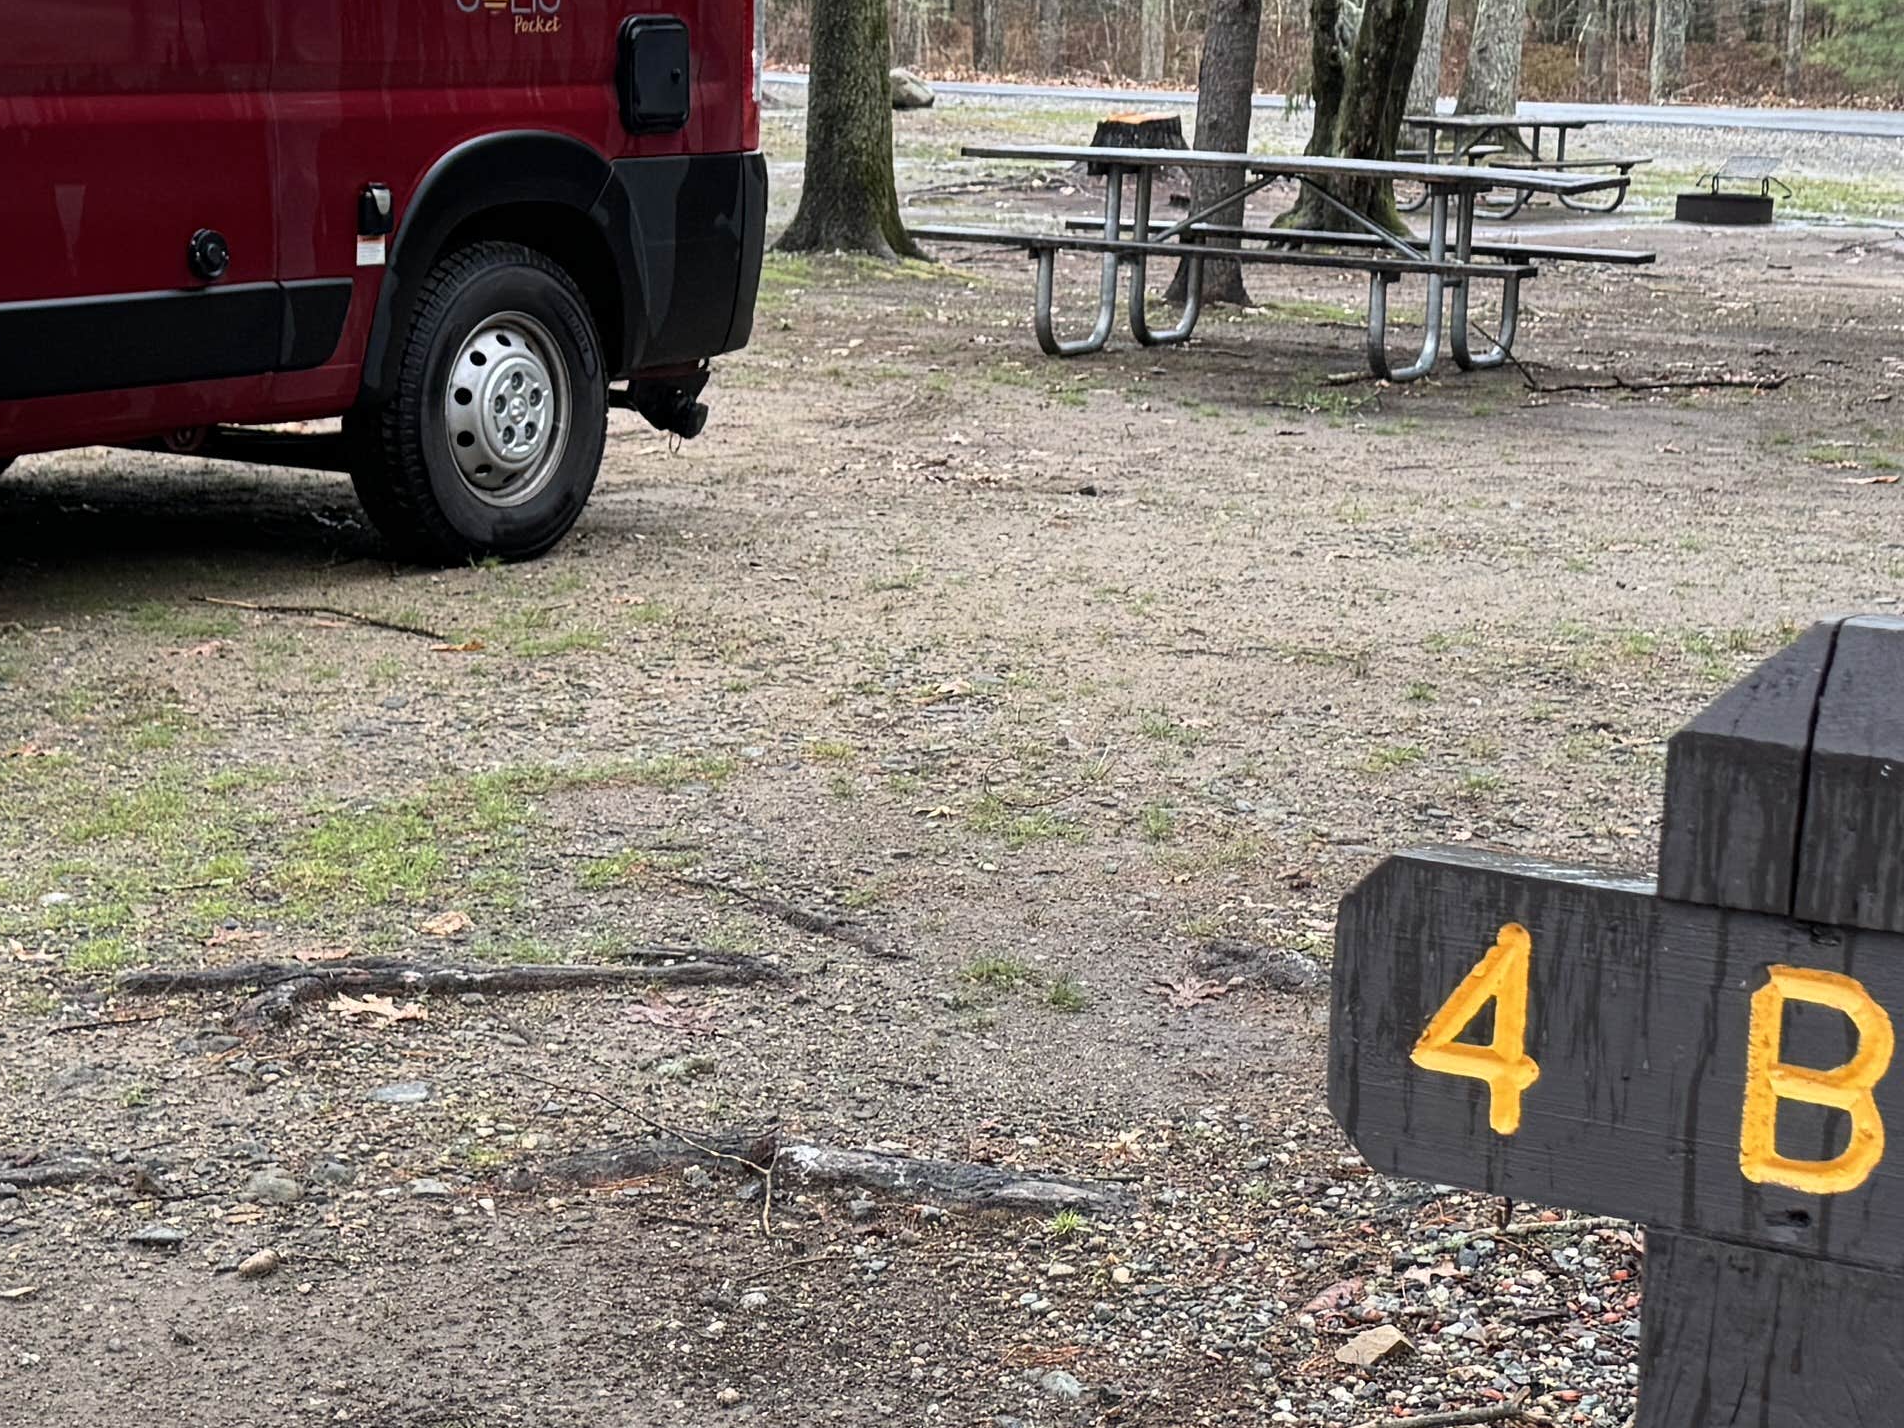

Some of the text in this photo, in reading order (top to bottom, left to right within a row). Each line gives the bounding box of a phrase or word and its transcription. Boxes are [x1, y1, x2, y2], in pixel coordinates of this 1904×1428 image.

[514, 14, 562, 35] Pocket
[1410, 921, 1541, 1135] 4
[1738, 963, 1896, 1195] B
